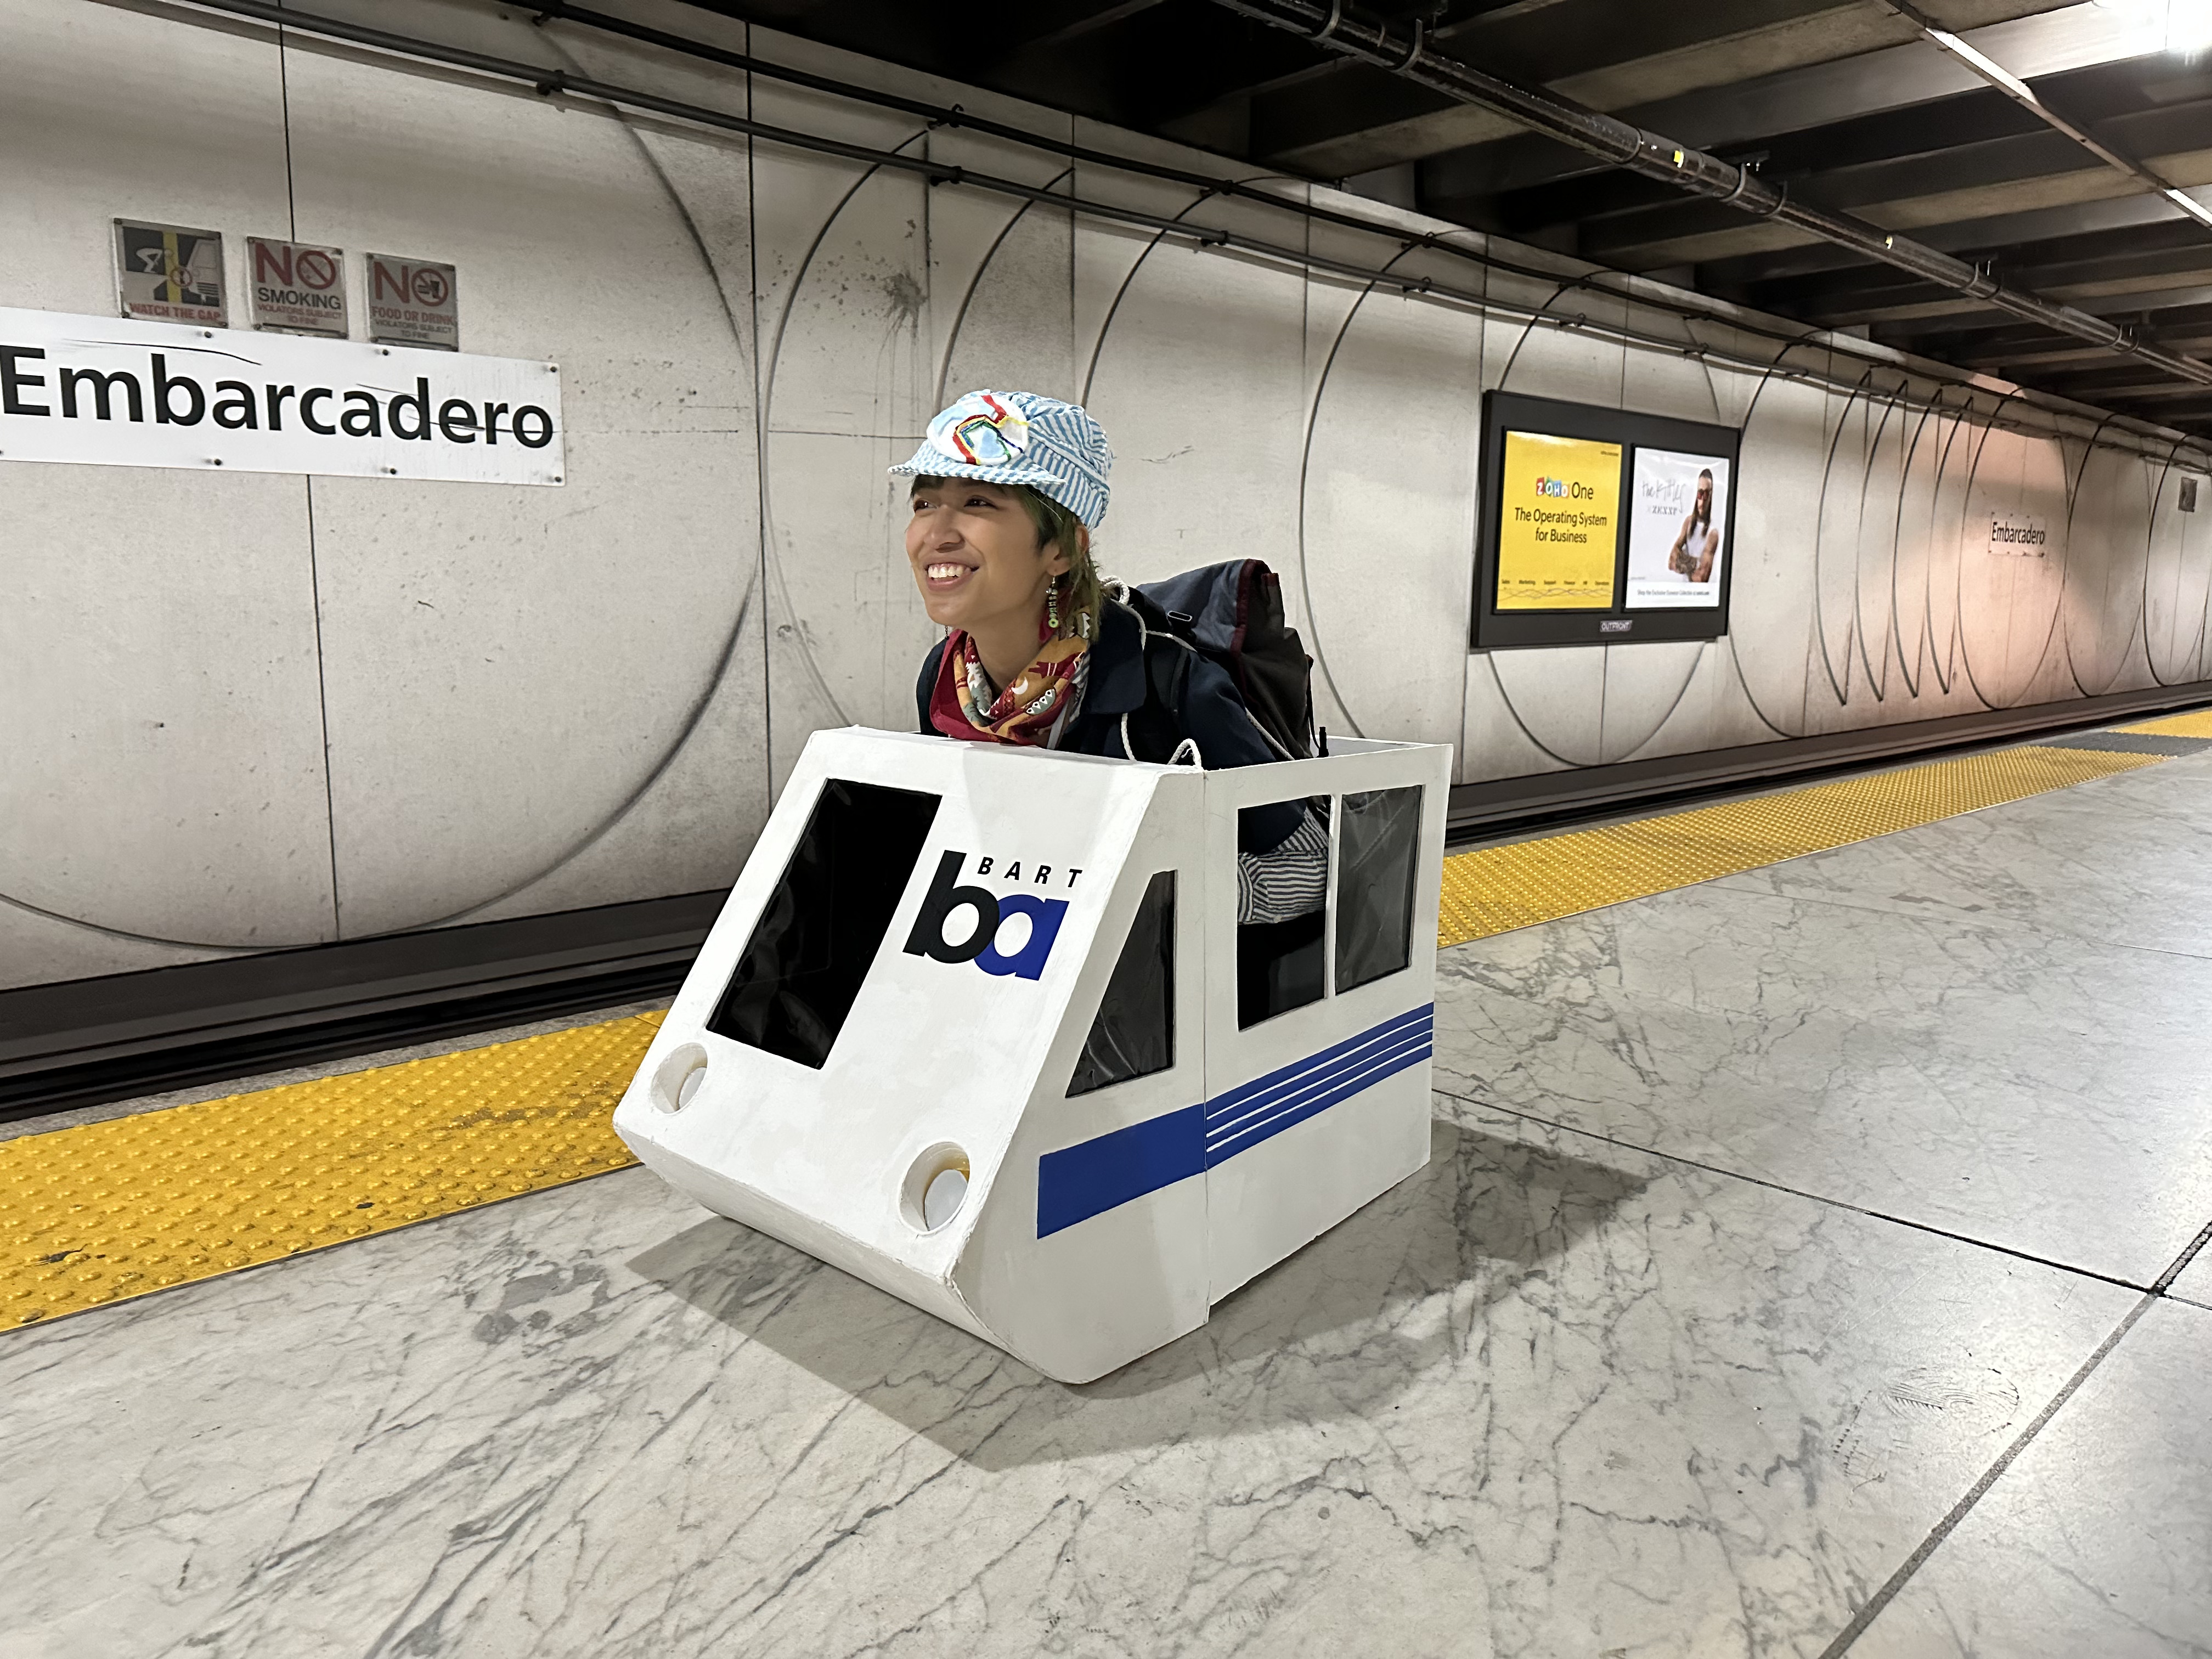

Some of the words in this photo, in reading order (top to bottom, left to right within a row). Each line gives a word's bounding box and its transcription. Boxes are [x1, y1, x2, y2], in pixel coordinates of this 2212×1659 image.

[258, 287, 341, 310] SMOKING
[129, 302, 170, 317] WATCH
[172, 307, 194, 319] THE
[198, 309, 221, 320] GAP
[257, 303, 304, 315] VIOLATORS
[306, 308, 342, 319] SUBJECT
[288, 315, 298, 324] TO
[300, 317, 318, 325] FINE
[371, 306, 401, 319] FOOD
[404, 310, 419, 321] OR
[421, 312, 453, 325] DRINK
[375, 319, 418, 330] VIOLATORS
[419, 324, 452, 334] SUBJECT
[413, 331, 430, 339] FINE
[0, 345, 553, 449] Embarcadero
[1537, 478, 1570, 498] ZOHO
[1572, 482, 1594, 500] One
[1515, 507, 1532, 522] The
[1533, 509, 1577, 527] Operating
[1579, 512, 1607, 527] System
[1535, 527, 1549, 541] for
[1550, 528, 1587, 543] Business
[1991, 521, 2045, 545] Embarcadero
[977, 856, 1083, 888] BART
[902, 849, 1070, 981] ba
